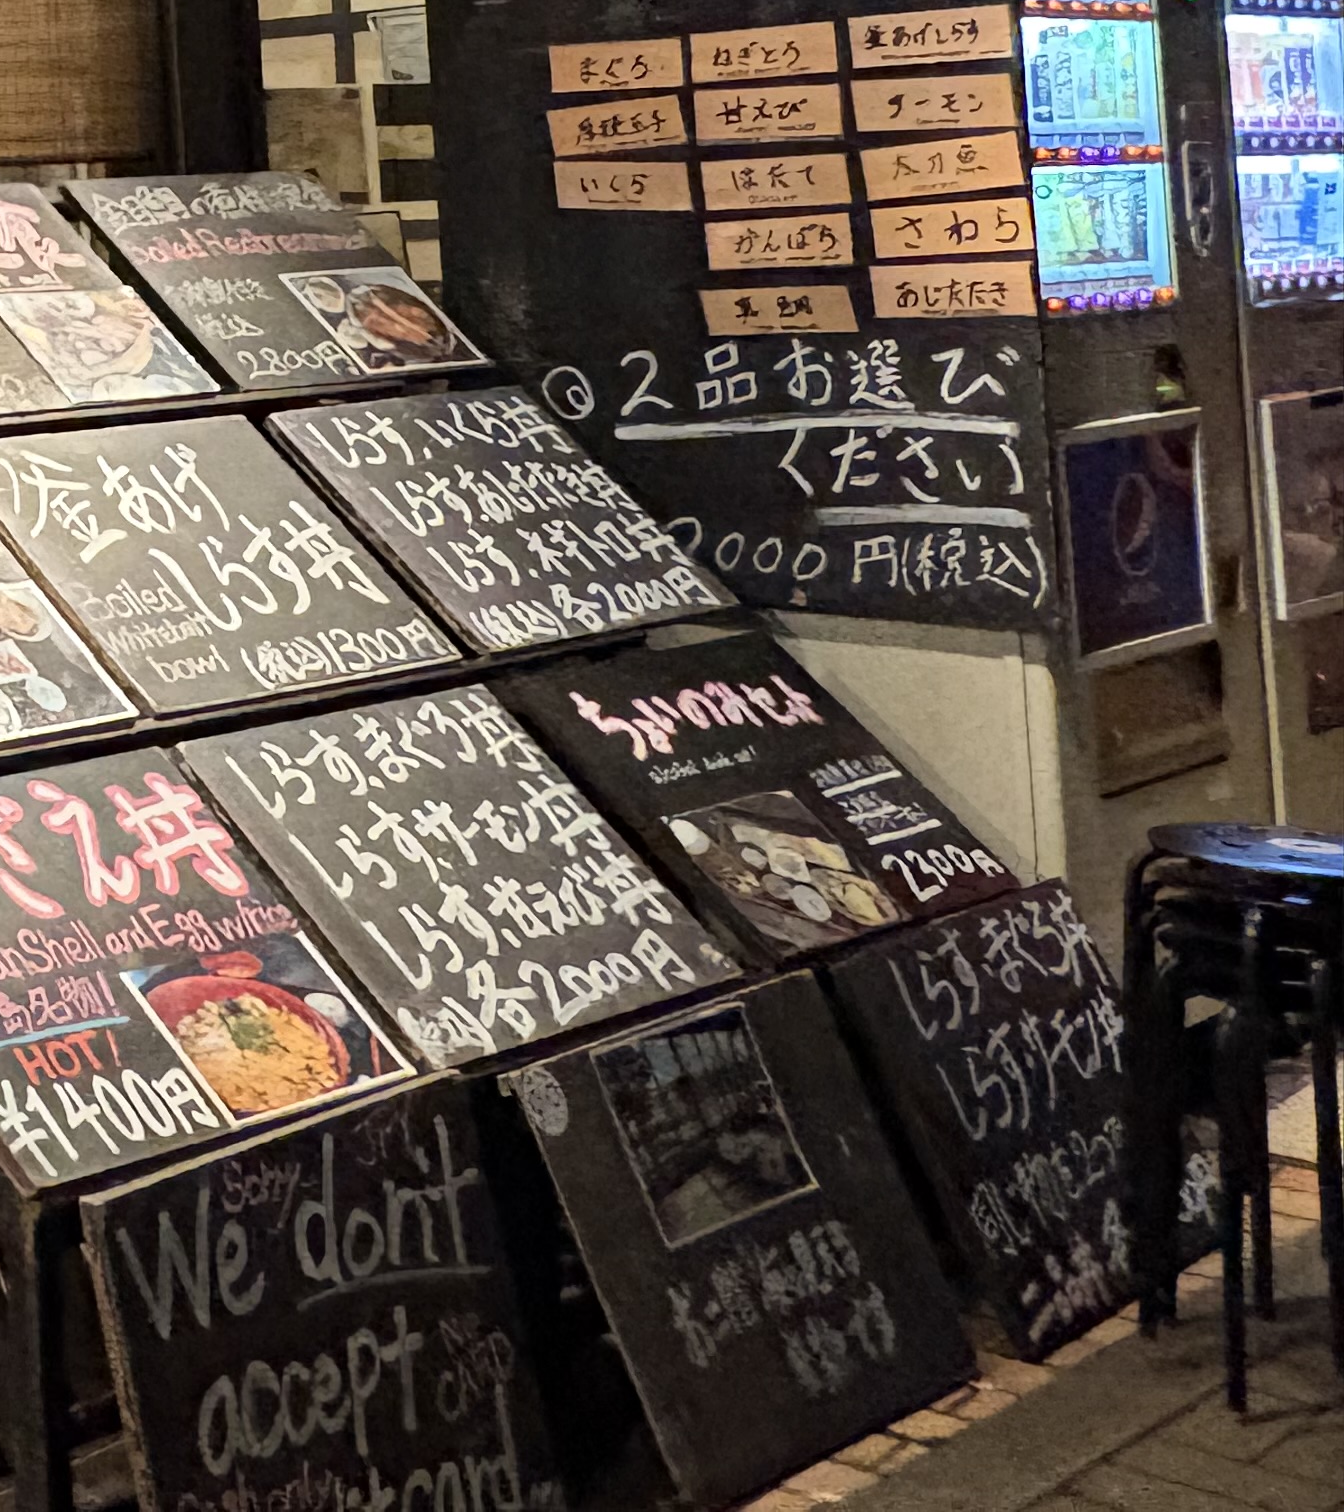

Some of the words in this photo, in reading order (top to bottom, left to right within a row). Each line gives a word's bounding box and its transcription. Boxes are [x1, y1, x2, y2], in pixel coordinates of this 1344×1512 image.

[716, 95, 808, 125] 甘えび
[731, 163, 815, 192] ほたて
[897, 207, 1021, 249] さわら
[620, 338, 1022, 416] 2品お選び
[778, 426, 1024, 503] ください
[148, 501, 390, 631] しらす丼
[115, 1184, 267, 1341] We
